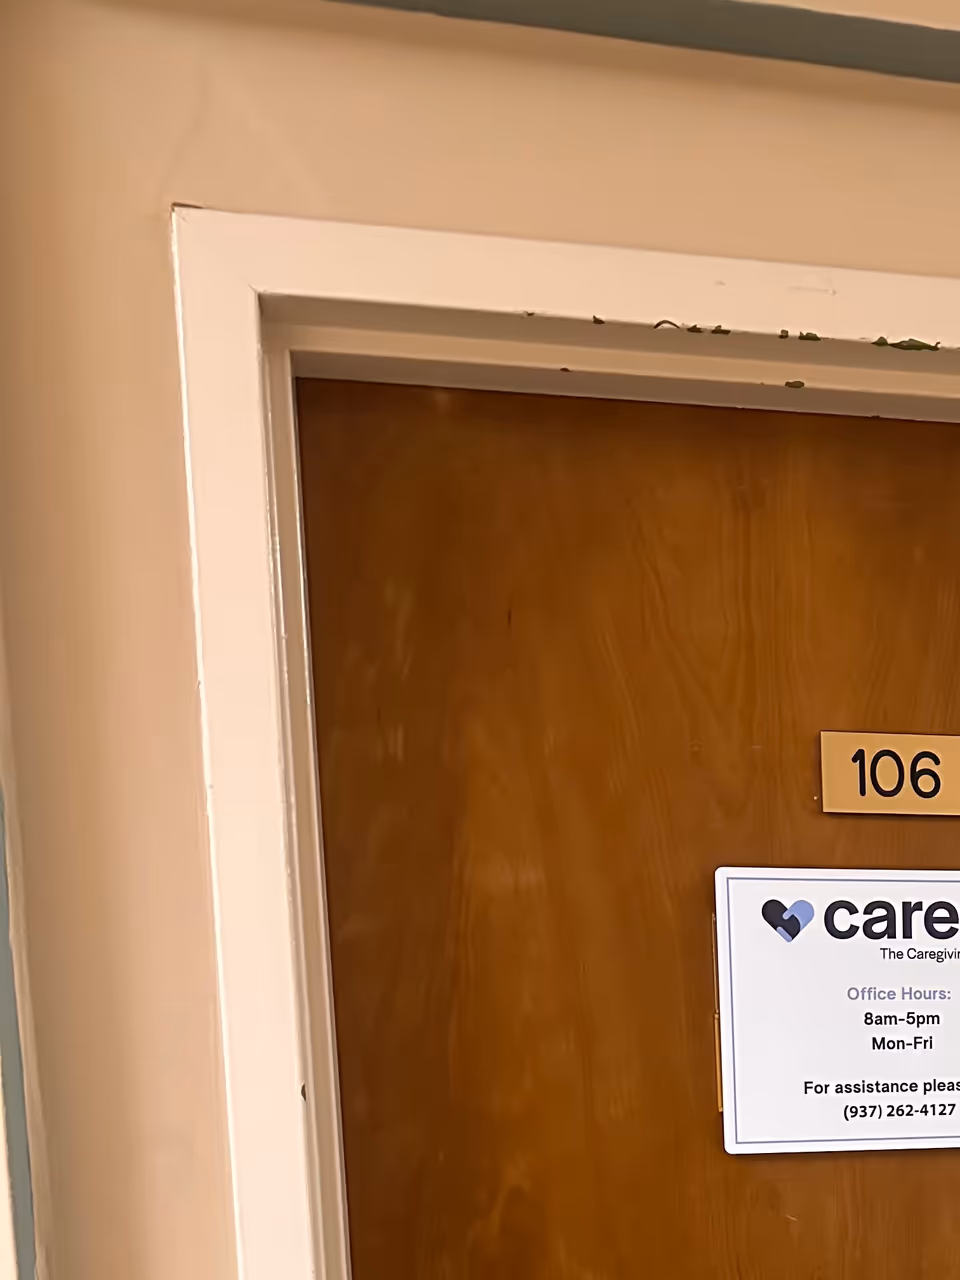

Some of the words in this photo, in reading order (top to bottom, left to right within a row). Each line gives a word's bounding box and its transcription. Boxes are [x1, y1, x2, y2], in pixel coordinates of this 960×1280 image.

[851, 748, 941, 799] 106
[879, 947, 905, 961] The
[846, 986, 897, 1001] Office
[901, 986, 952, 1001] Hours:
[863, 1011, 941, 1029] 8am-5pm
[871, 1035, 933, 1051] Mon-Fri
[803, 1080, 831, 1095] For
[834, 1079, 919, 1095] assistance
[843, 1104, 883, 1122] (937)
[886, 1103, 957, 1118] 262-4127
